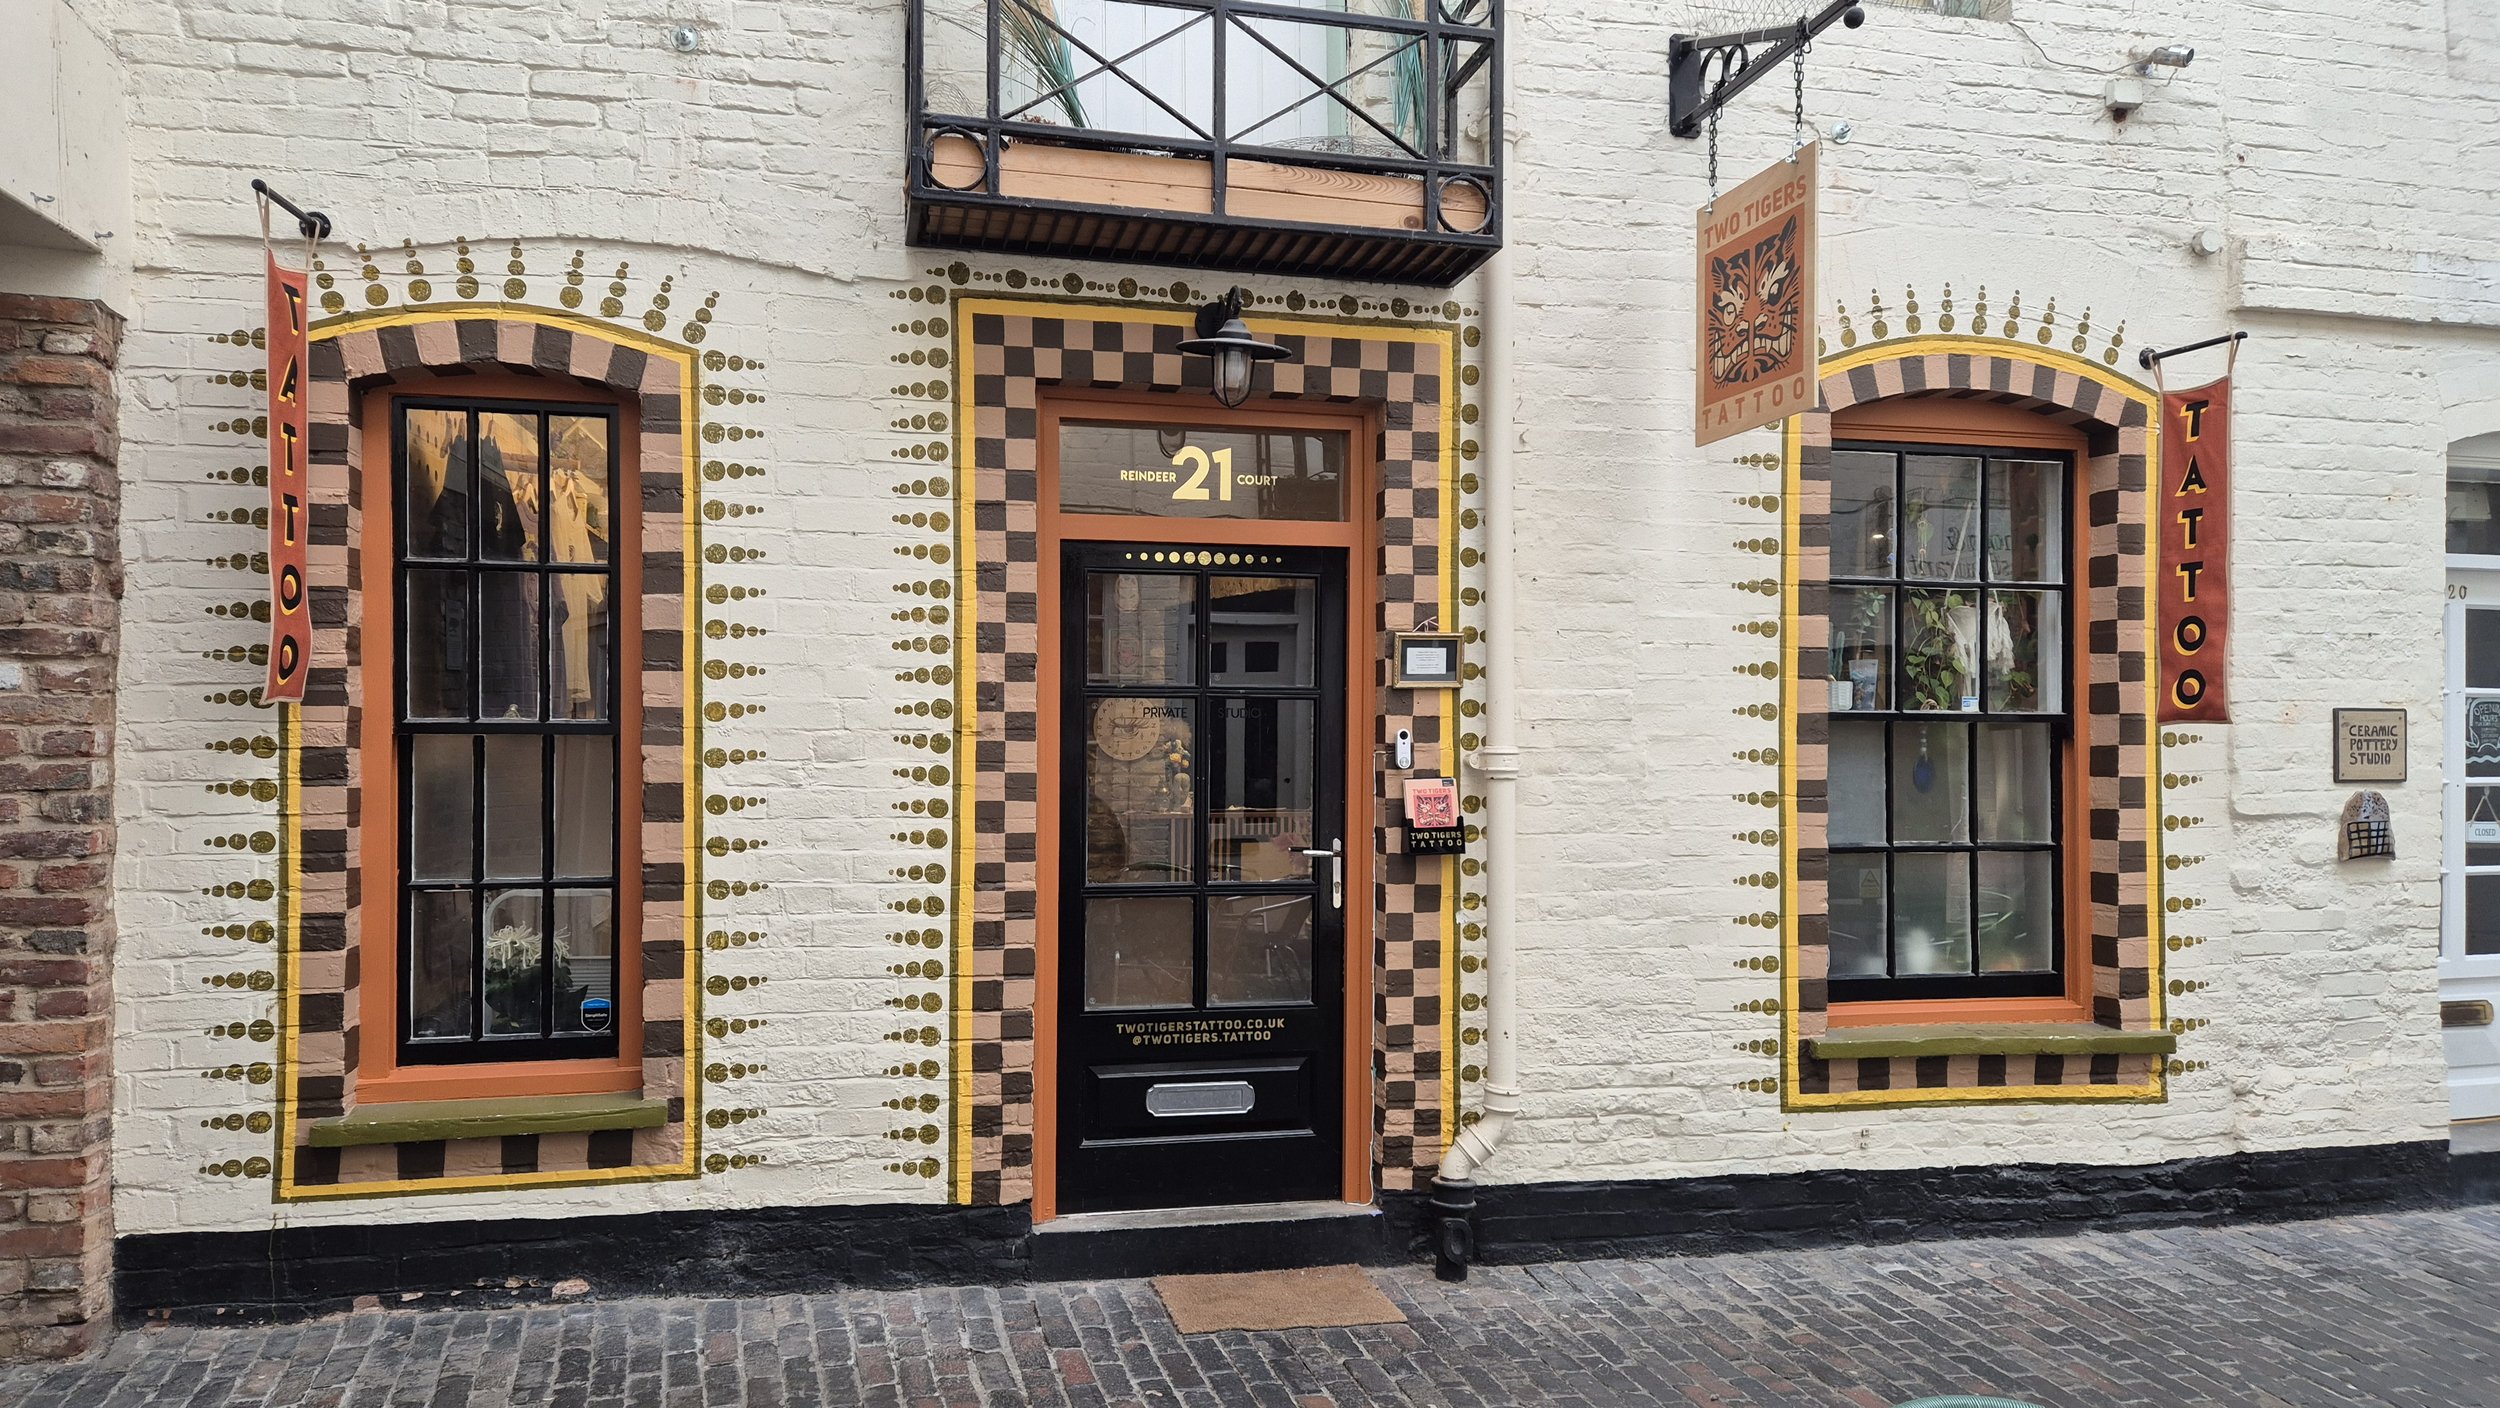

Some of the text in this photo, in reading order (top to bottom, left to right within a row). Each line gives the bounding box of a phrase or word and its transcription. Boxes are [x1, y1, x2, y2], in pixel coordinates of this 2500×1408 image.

[1704, 174, 1807, 249] TWO TIGERS
[1702, 376, 1805, 430] TATTOO
[1120, 445, 1278, 501] REINDEER 21 COURT
[277, 281, 302, 686] TATTOO
[2172, 399, 2210, 710] TATTOO
[2447, 584, 2467, 600] 20
[1143, 707, 1261, 719] PRIVATE STUDIO
[2480, 714, 2498, 722] HOURS
[2349, 725, 2398, 737] CERAMIC
[2350, 738, 2398, 751] POTTERY
[2349, 752, 2391, 765] STUDIO
[1410, 831, 1462, 840] TWO TIGERS
[2475, 828, 2496, 836] CLOSED
[1411, 839, 1462, 848] TATTOO
[1116, 1018, 1285, 1034] TWOTIGERSTATTOO.CO.UK
[1132, 1031, 1271, 1045] @TWOTIGERS.TATTOO
